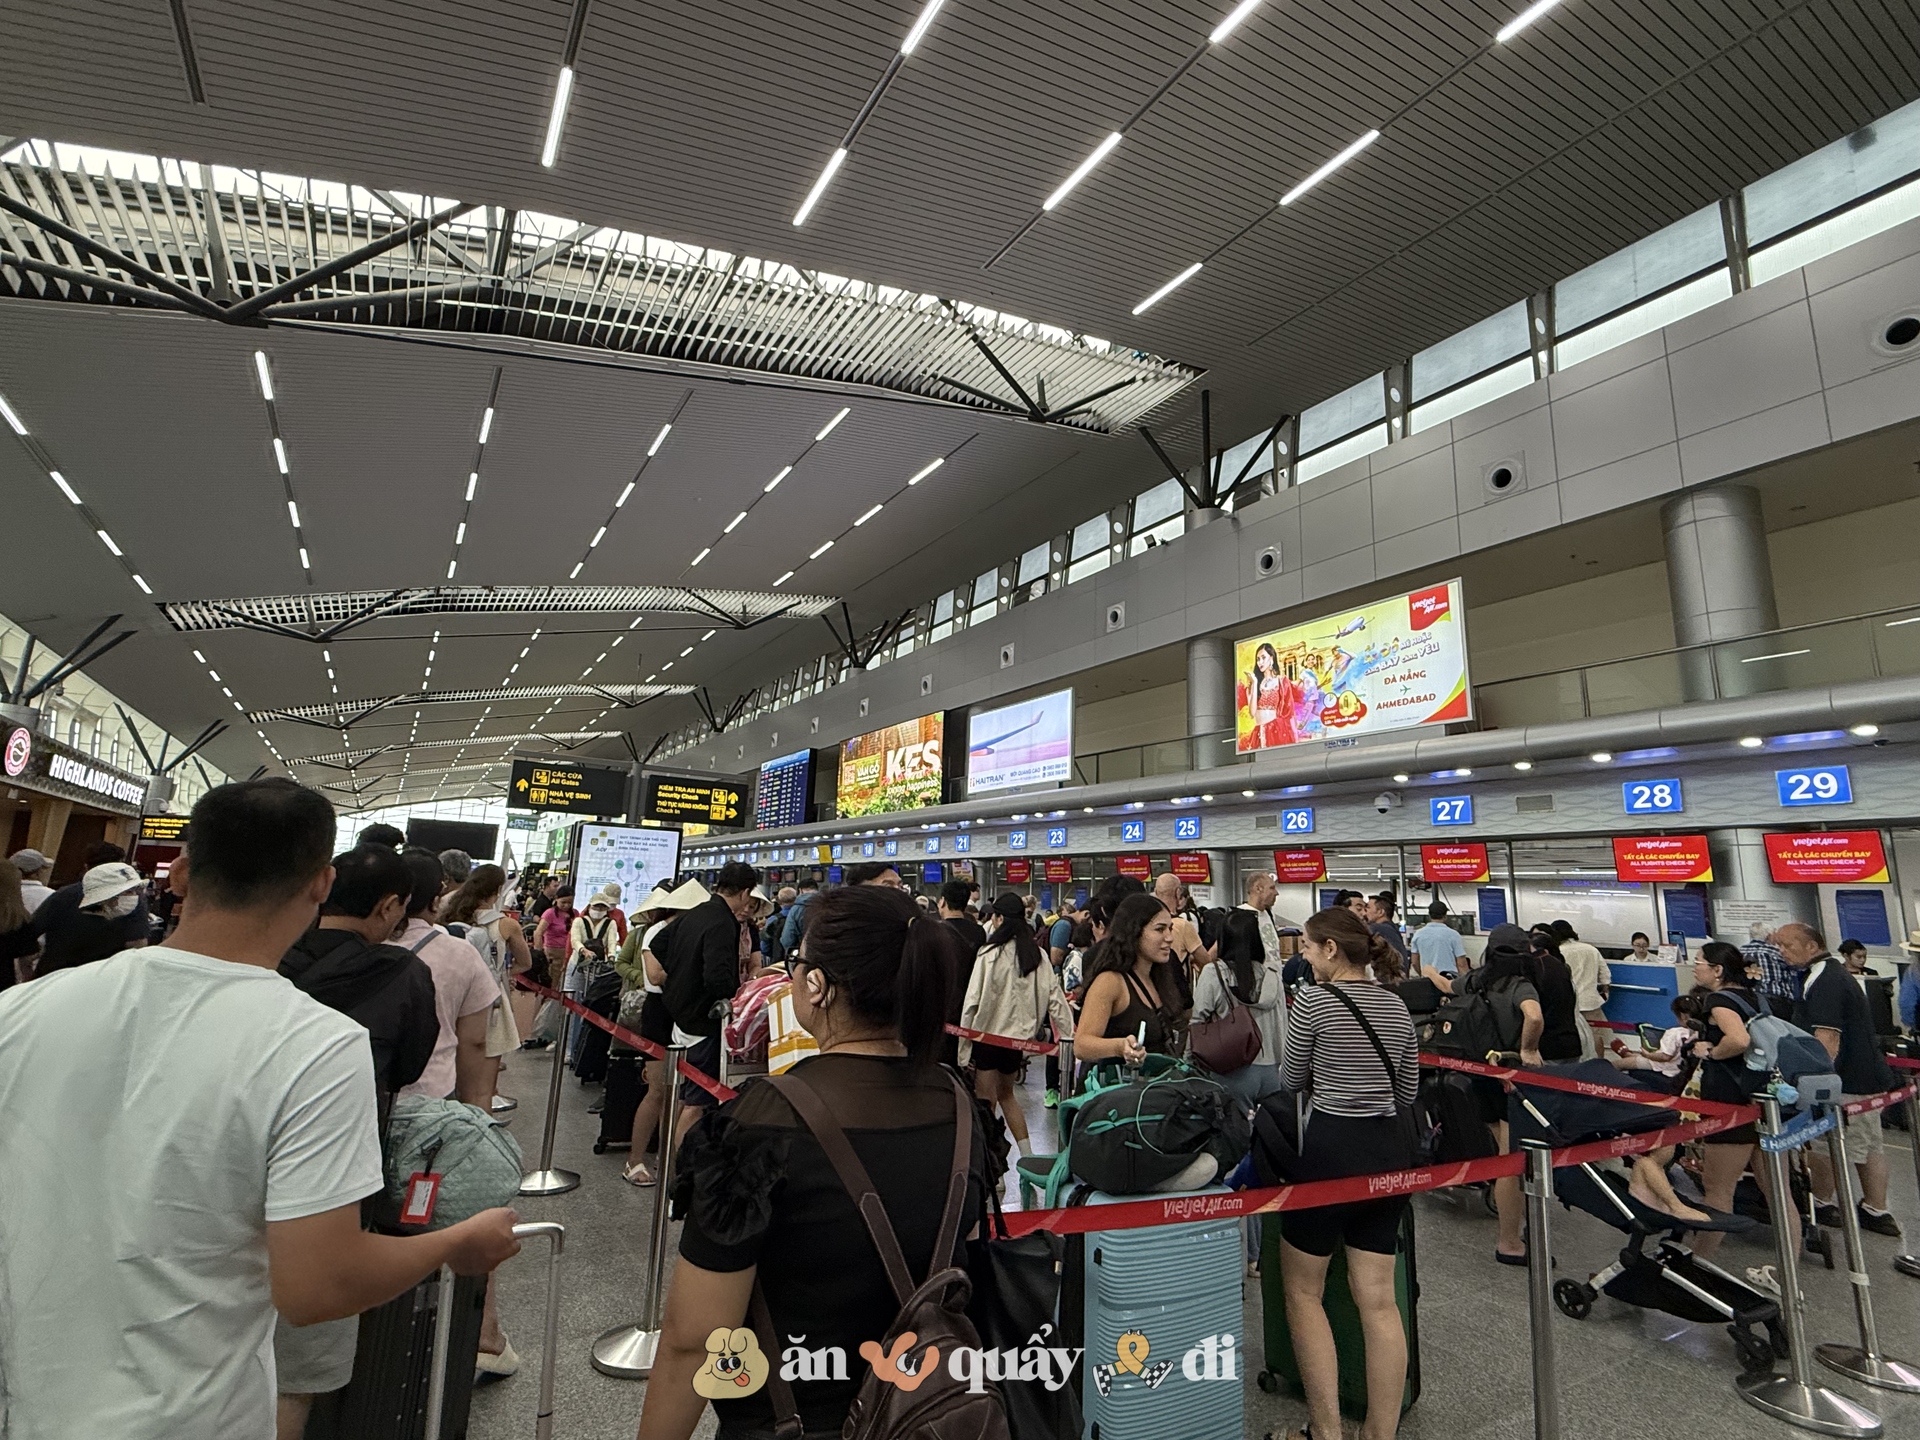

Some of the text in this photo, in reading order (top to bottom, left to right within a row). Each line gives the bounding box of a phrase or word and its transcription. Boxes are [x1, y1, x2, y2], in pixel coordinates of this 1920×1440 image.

[1376, 693, 1436, 710] AHMEDABAD
[887, 740, 941, 783] KES
[48, 754, 144, 805] HIGHLANDS COFFEE
[1788, 772, 1838, 800] 29
[657, 791, 680, 799] Security
[1632, 784, 1673, 809] 28
[1436, 800, 1465, 820] 27
[1287, 812, 1308, 829] 26
[1125, 825, 1140, 839] 24
[1179, 821, 1196, 836] 25
[958, 838, 967, 849] 21
[1012, 834, 1023, 846] 22
[1050, 831, 1063, 844] 23
[865, 845, 872, 855] 18
[887, 844, 895, 854] 19
[928, 840, 937, 851] 20
